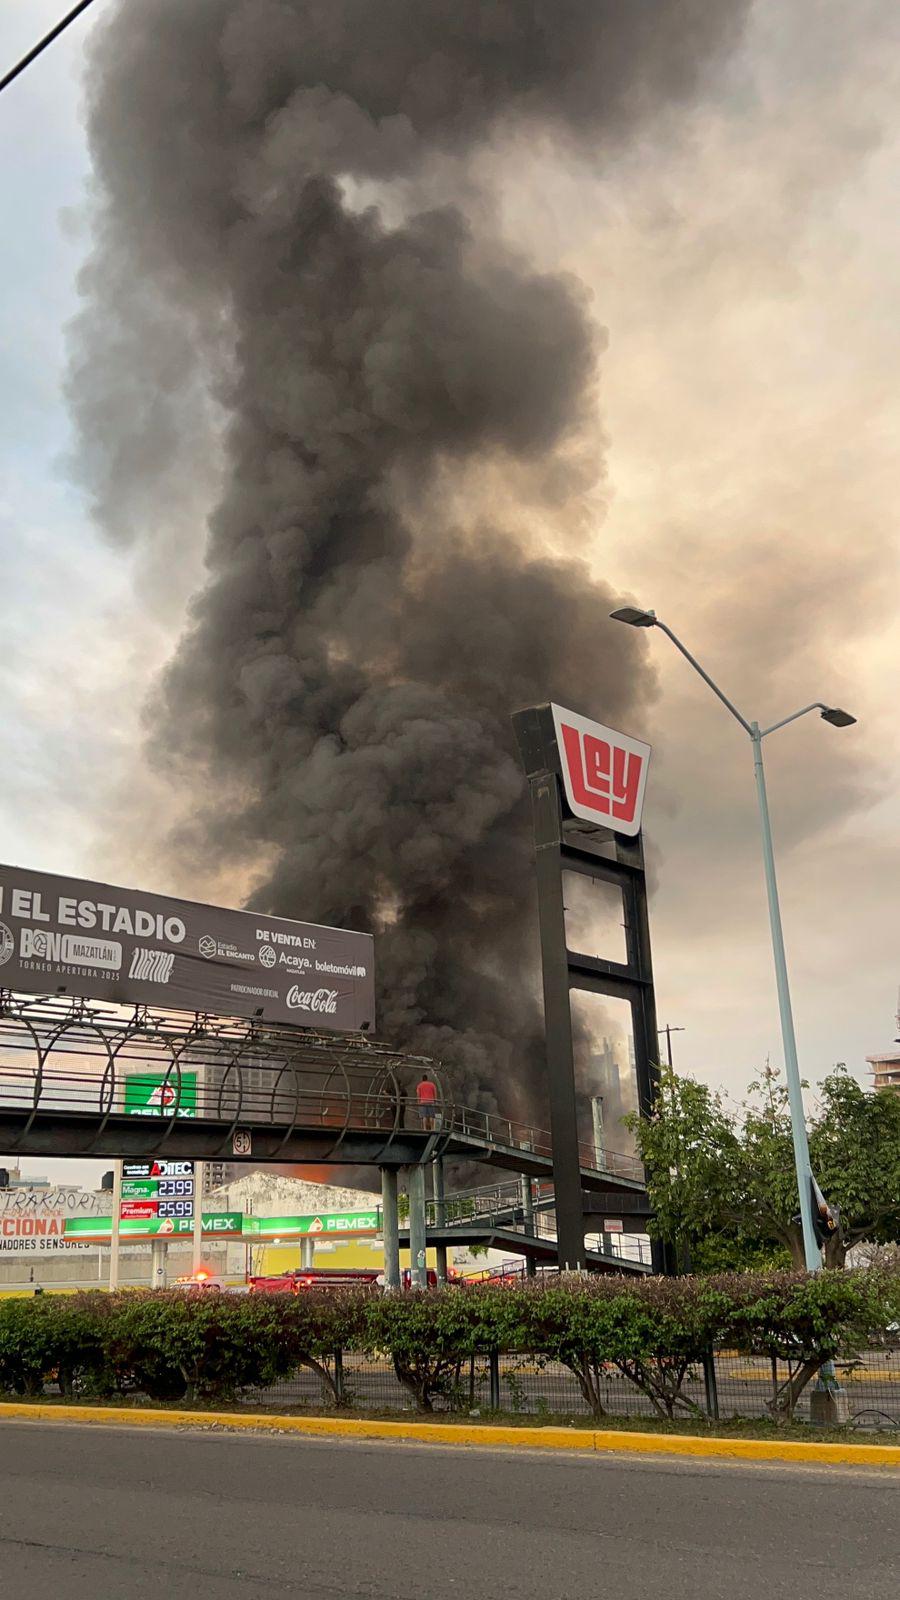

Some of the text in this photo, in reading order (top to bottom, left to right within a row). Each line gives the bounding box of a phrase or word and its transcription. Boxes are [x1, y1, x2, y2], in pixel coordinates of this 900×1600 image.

[11, 888, 50, 921] EL
[57, 896, 186, 944] ESTADIO
[256, 929, 270, 941] DE
[271, 932, 302, 948] VENTA
[73, 943, 113, 961] MAZATLÁN
[19, 960, 120, 981] TORNEO APERTURA 2025
[286, 984, 338, 1014] Coca-Cola
[122, 1186, 148, 1195] Magna
[121, 1207, 153, 1215] Premium
[179, 1218, 234, 1231] PEMEX
[327, 1217, 376, 1230] PEMEX
